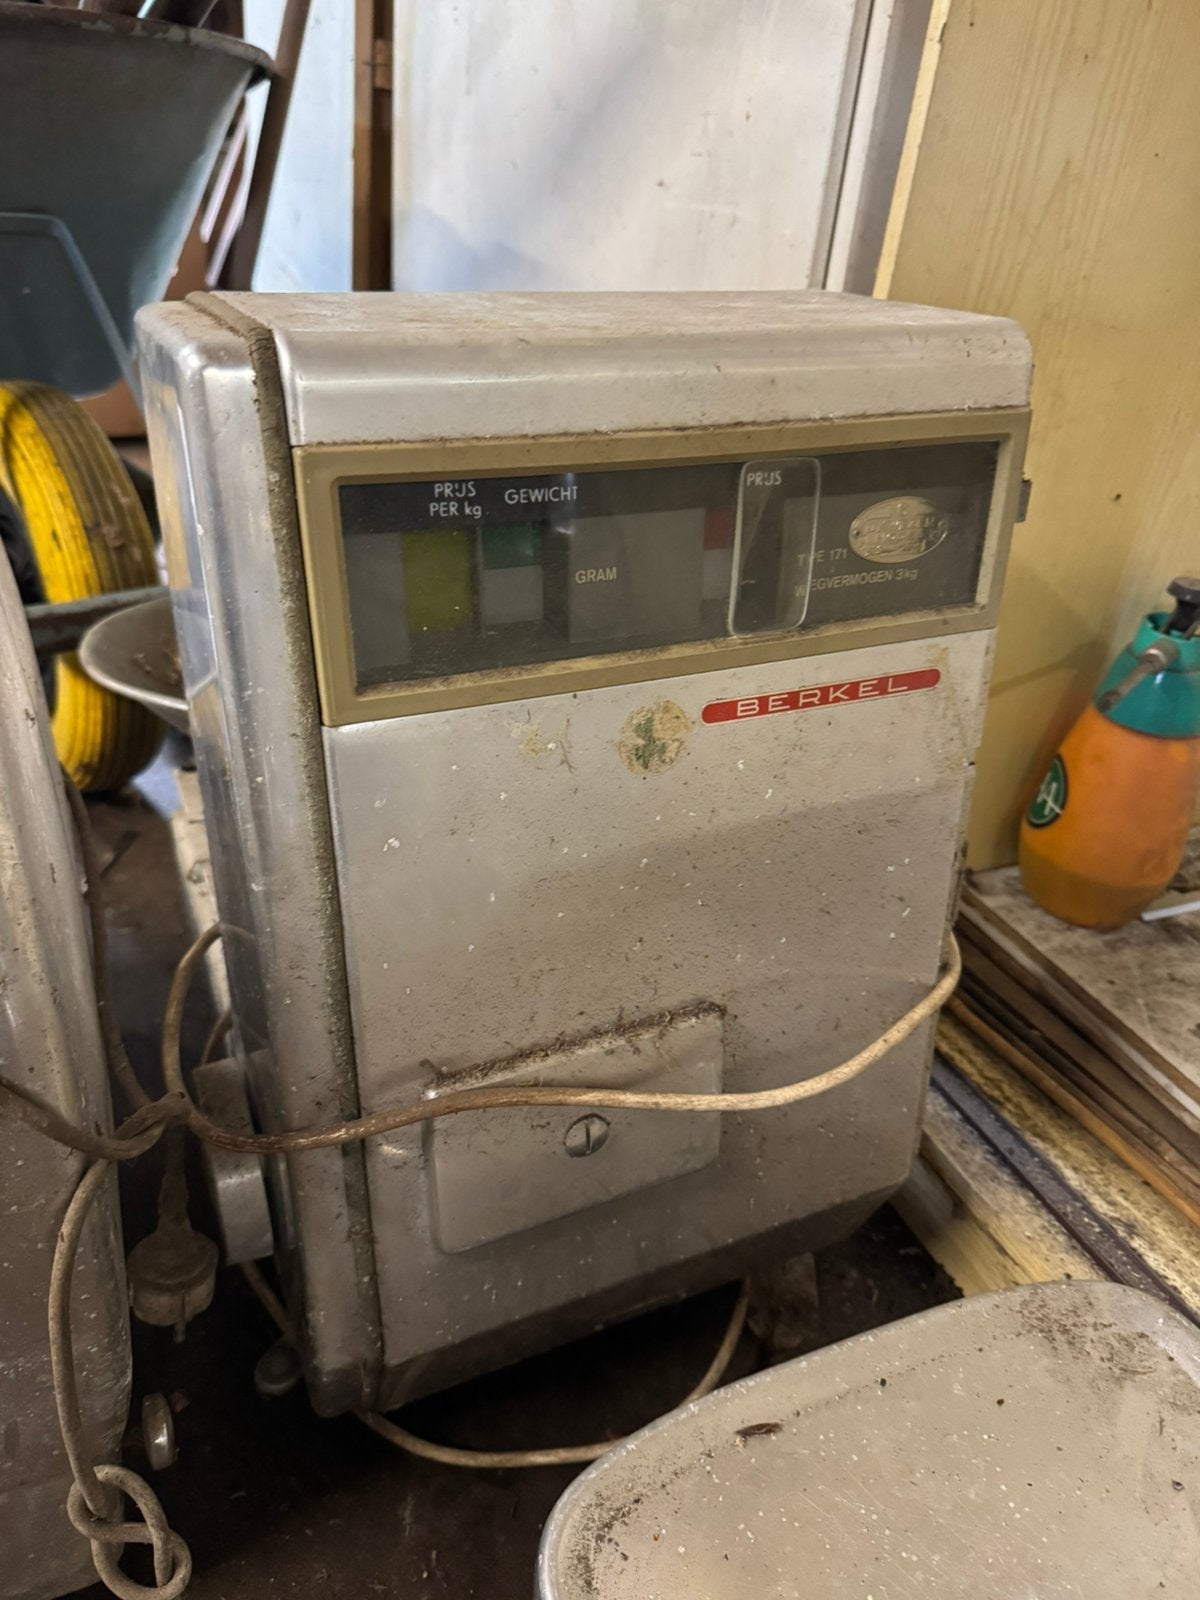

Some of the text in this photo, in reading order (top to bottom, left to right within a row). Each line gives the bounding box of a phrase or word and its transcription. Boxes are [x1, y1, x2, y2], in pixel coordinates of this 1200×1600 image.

[505, 486, 578, 505] GEWICHT
[430, 501, 482, 519] PER kg
[829, 547, 848, 562] 171
[576, 567, 617, 584] GRAM
[737, 677, 908, 717] BERKEL
